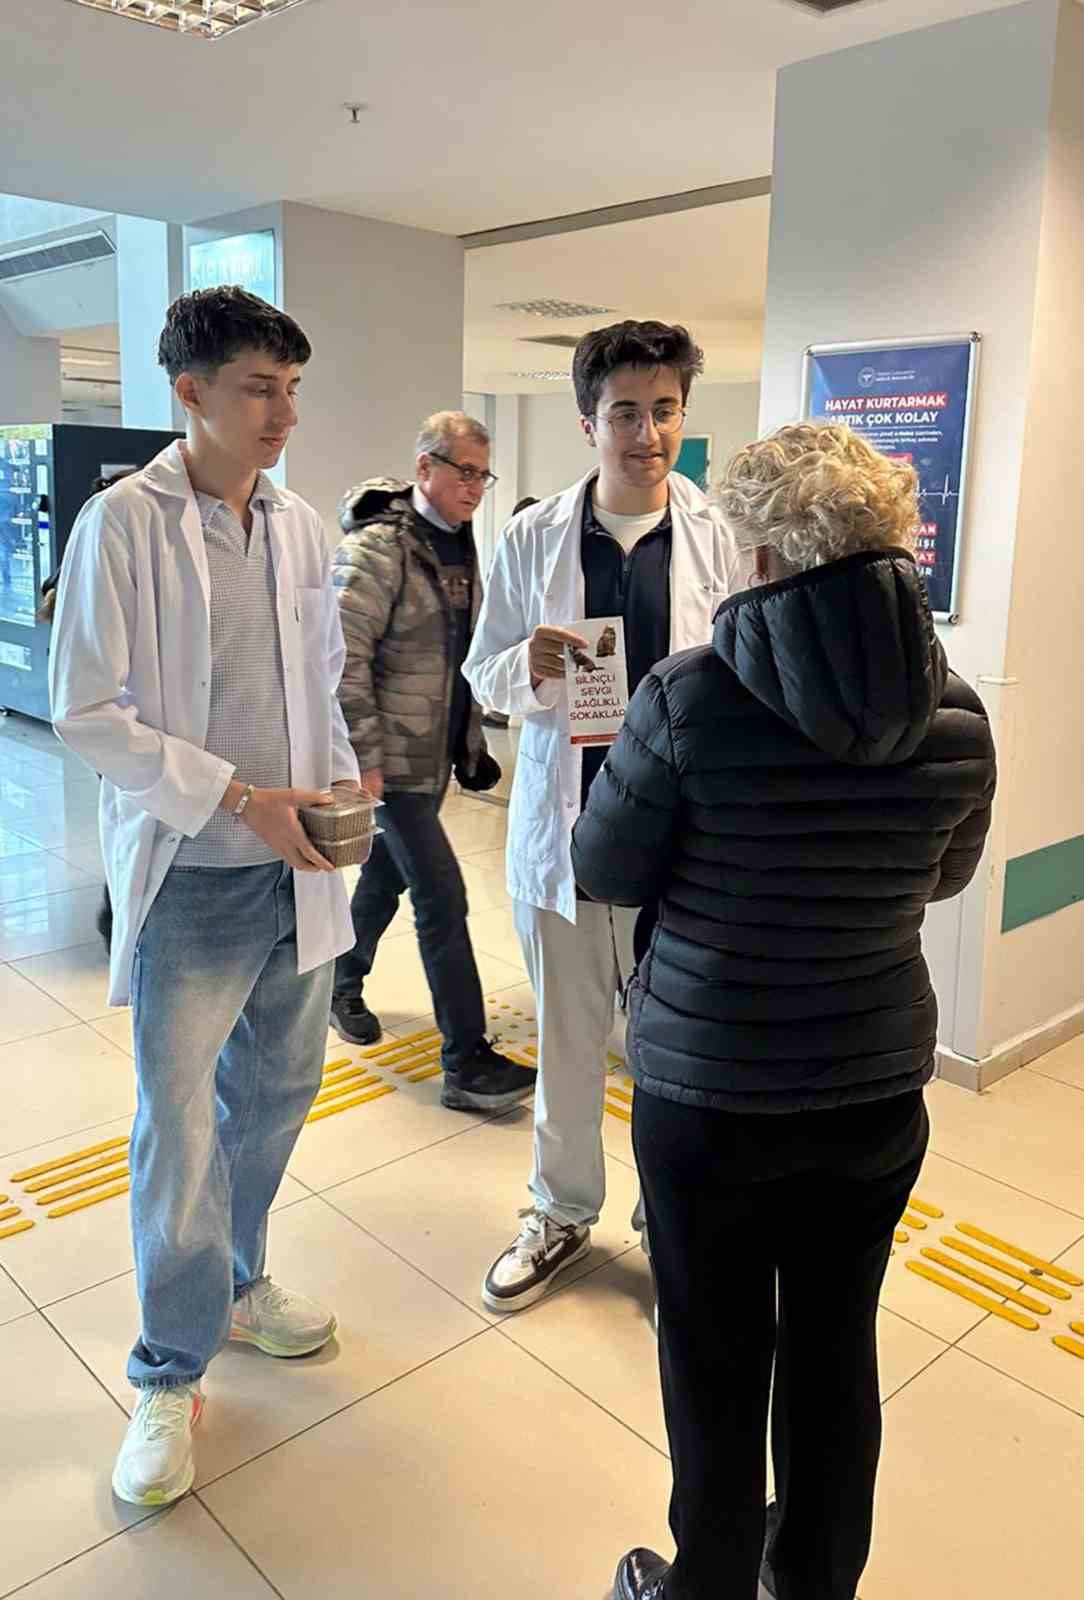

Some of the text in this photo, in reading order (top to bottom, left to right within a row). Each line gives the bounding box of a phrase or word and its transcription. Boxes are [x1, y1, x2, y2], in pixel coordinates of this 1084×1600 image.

[825, 394, 946, 411] HAYAT KURTARMAK
[866, 413, 893, 428] ÇOK
[895, 411, 938, 423] KOLAY
